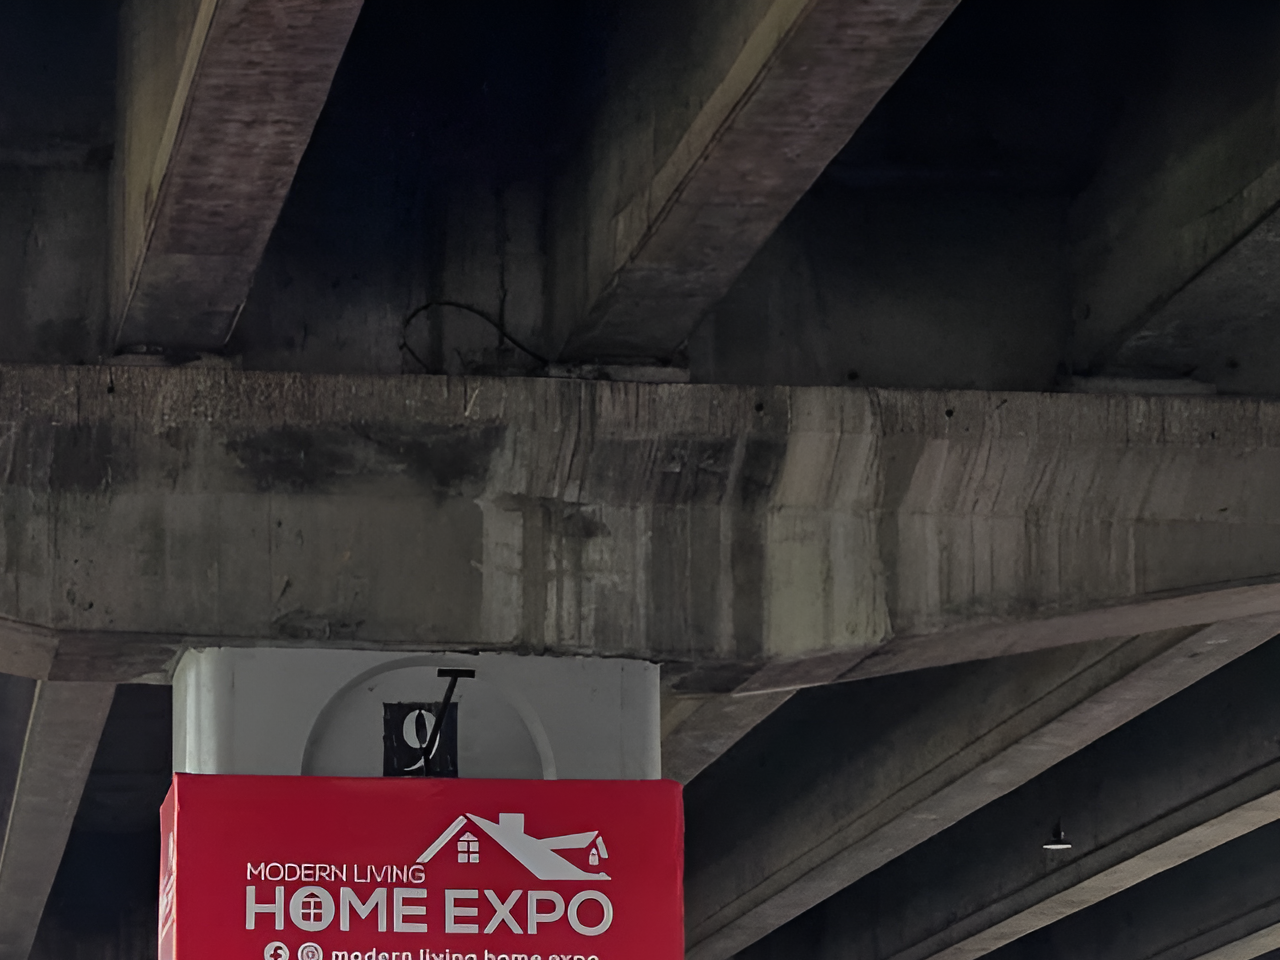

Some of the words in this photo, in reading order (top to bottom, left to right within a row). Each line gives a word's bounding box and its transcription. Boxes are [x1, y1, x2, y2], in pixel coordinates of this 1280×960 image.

[246, 862, 347, 882] MODERN
[353, 863, 426, 883] LIVING
[245, 885, 428, 933] HOME
[444, 888, 614, 937] EXPO
